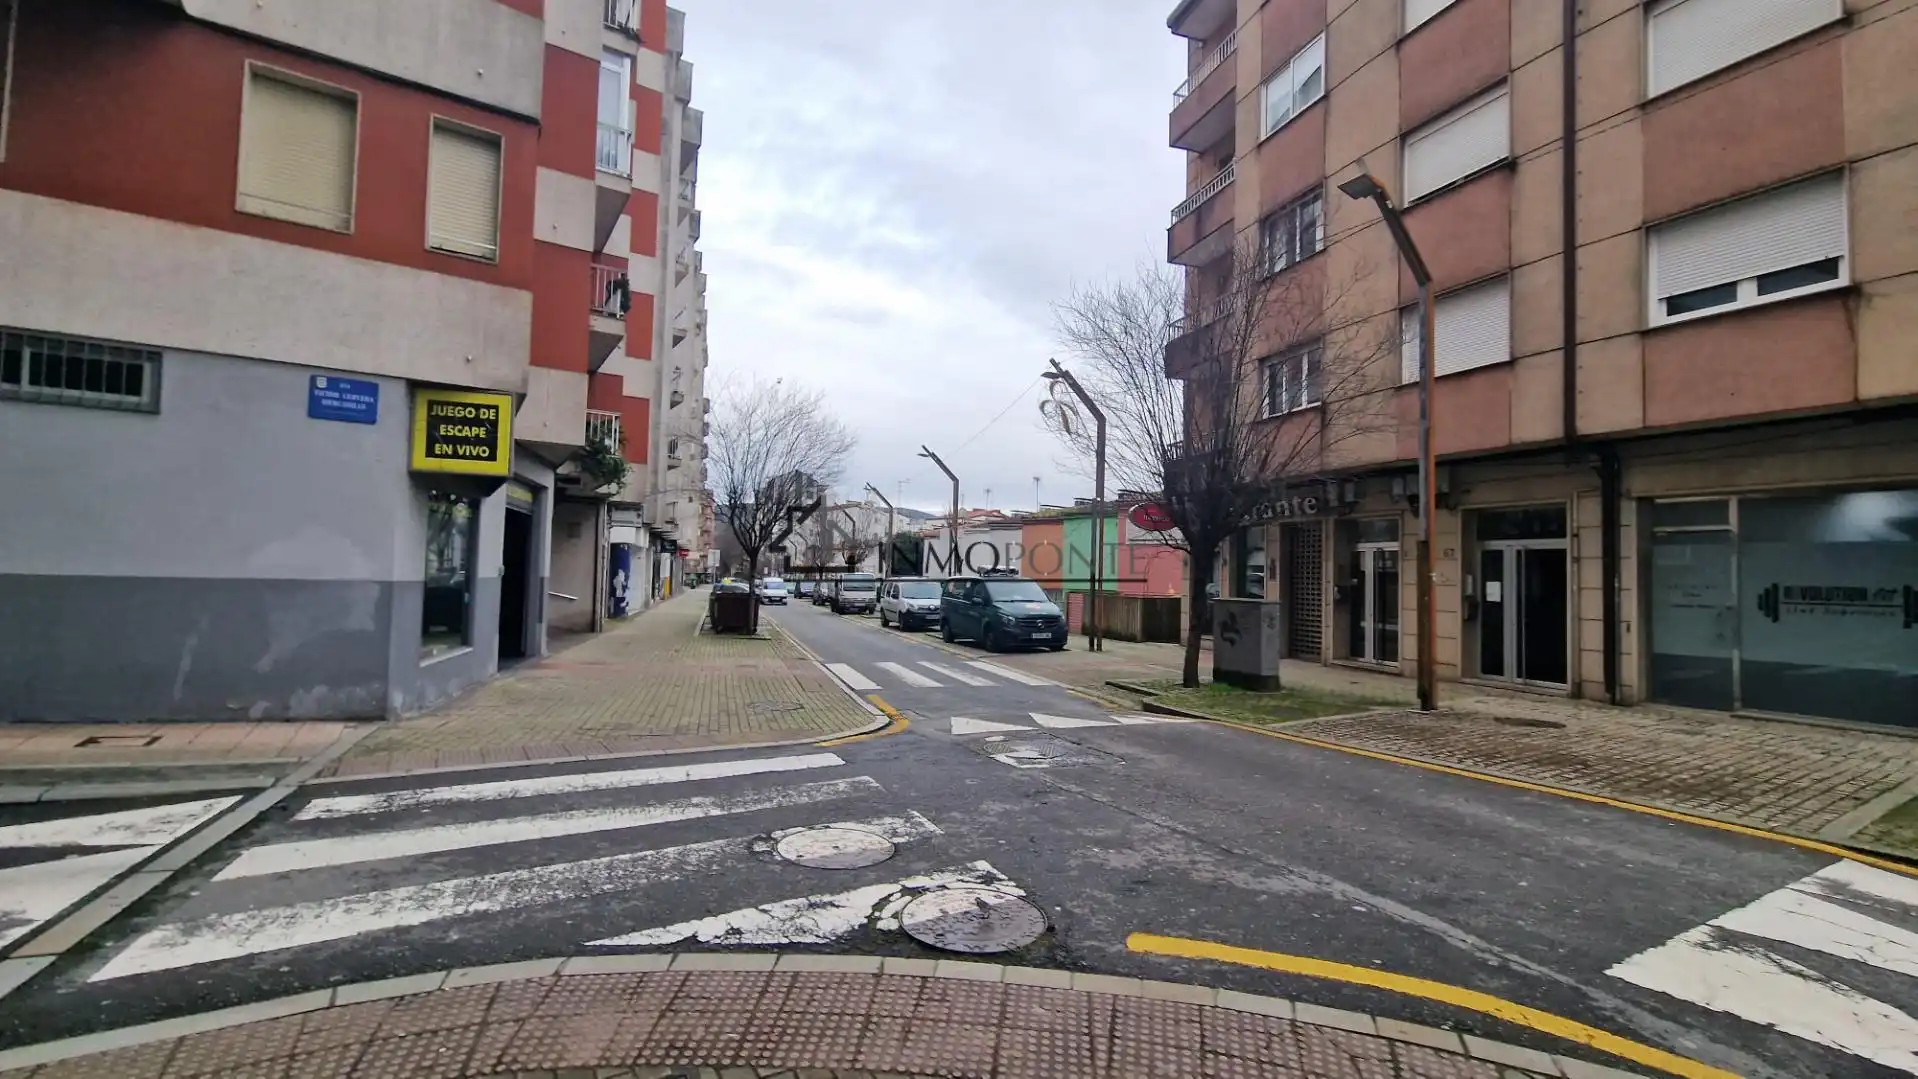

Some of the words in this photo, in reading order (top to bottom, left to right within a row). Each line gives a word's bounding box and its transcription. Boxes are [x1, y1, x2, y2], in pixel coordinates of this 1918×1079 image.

[430, 404, 476, 418] JUEGO
[479, 408, 497, 420] DE
[439, 424, 487, 438] ESCAPE
[434, 443, 453, 455] EN
[456, 444, 490, 457] VIVO
